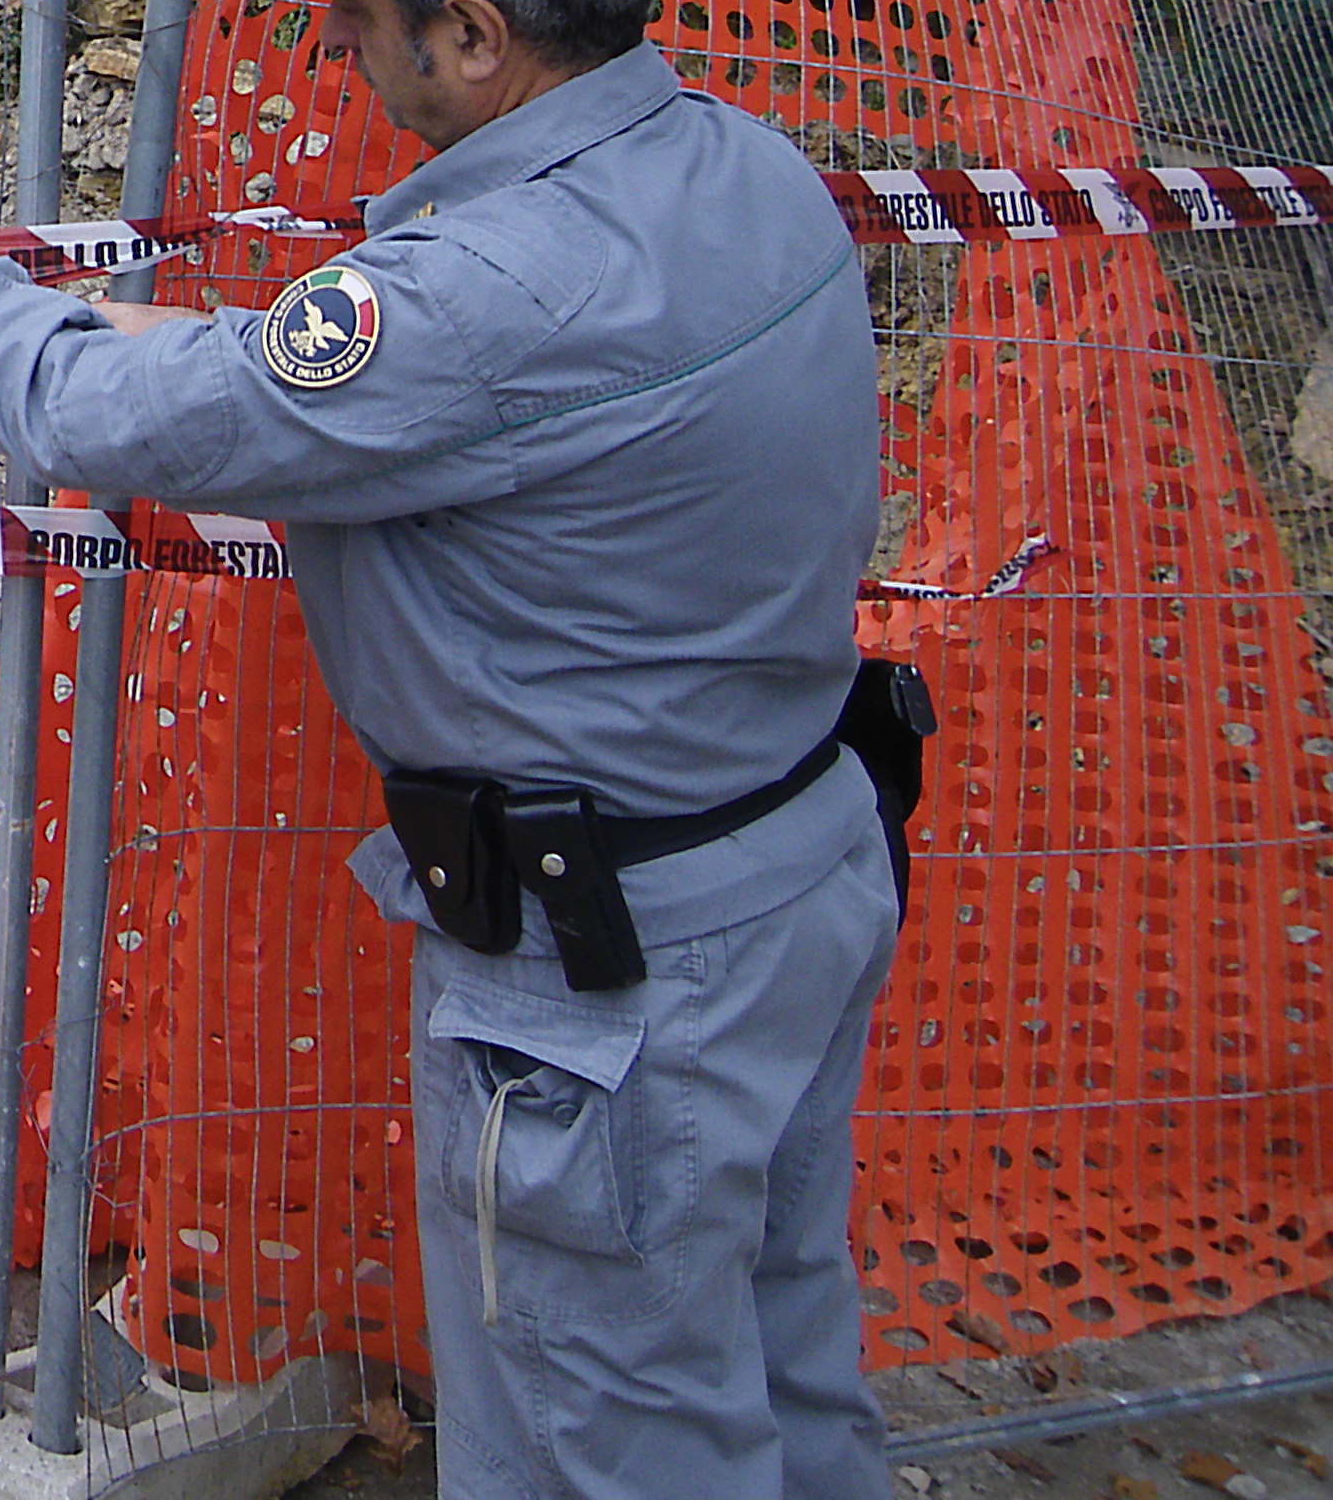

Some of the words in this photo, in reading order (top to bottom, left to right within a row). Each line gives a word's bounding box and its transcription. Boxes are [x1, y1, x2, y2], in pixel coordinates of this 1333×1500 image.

[978, 190, 1034, 229] DELLO
[295, 365, 333, 380] DELLO
[333, 341, 367, 375] STATO
[154, 536, 294, 580] FORESTAL
